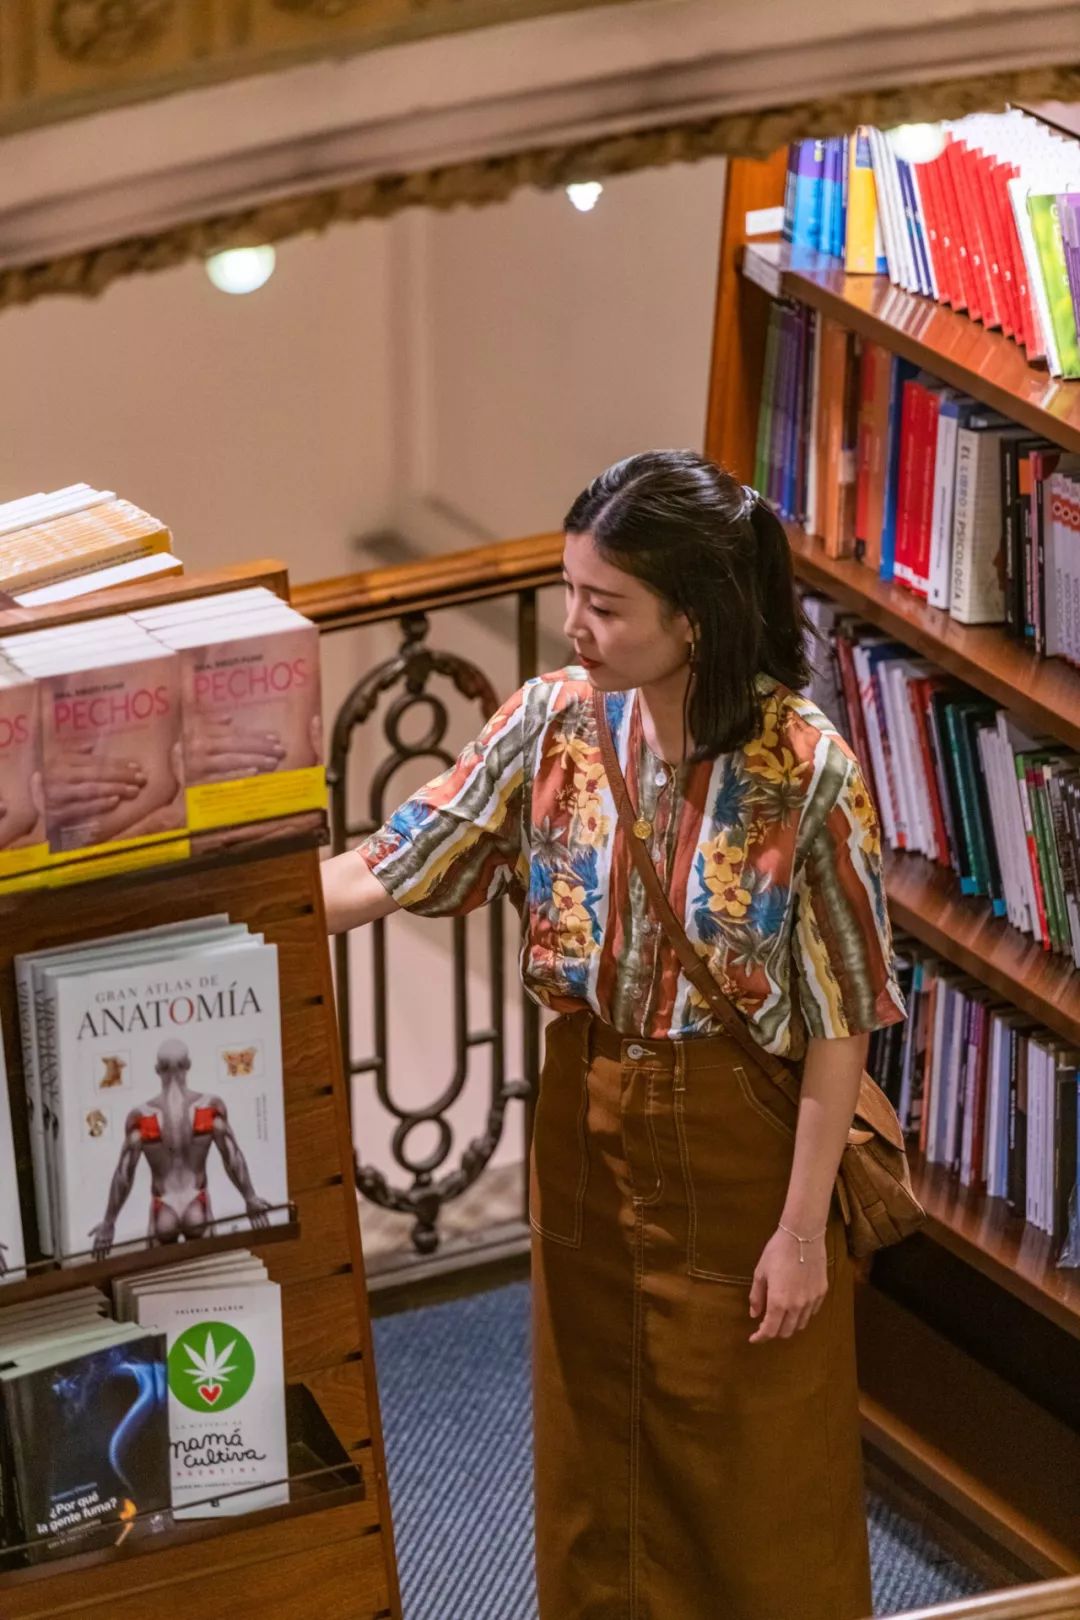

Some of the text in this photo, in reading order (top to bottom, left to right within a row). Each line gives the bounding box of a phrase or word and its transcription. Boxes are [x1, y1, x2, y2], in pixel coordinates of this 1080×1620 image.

[193, 658, 309, 702] PECHOS
[54, 685, 170, 733] PECHOS
[95, 974, 219, 1003] GRAN ATLAS DE
[76, 980, 262, 1041] ANATOMÍA
[36, 1522, 49, 1535] la
[49, 1511, 82, 1532] gente
[83, 1497, 118, 1519] fuma?
[49, 1499, 76, 1519] ¿Por
[77, 1491, 100, 1508] qué
